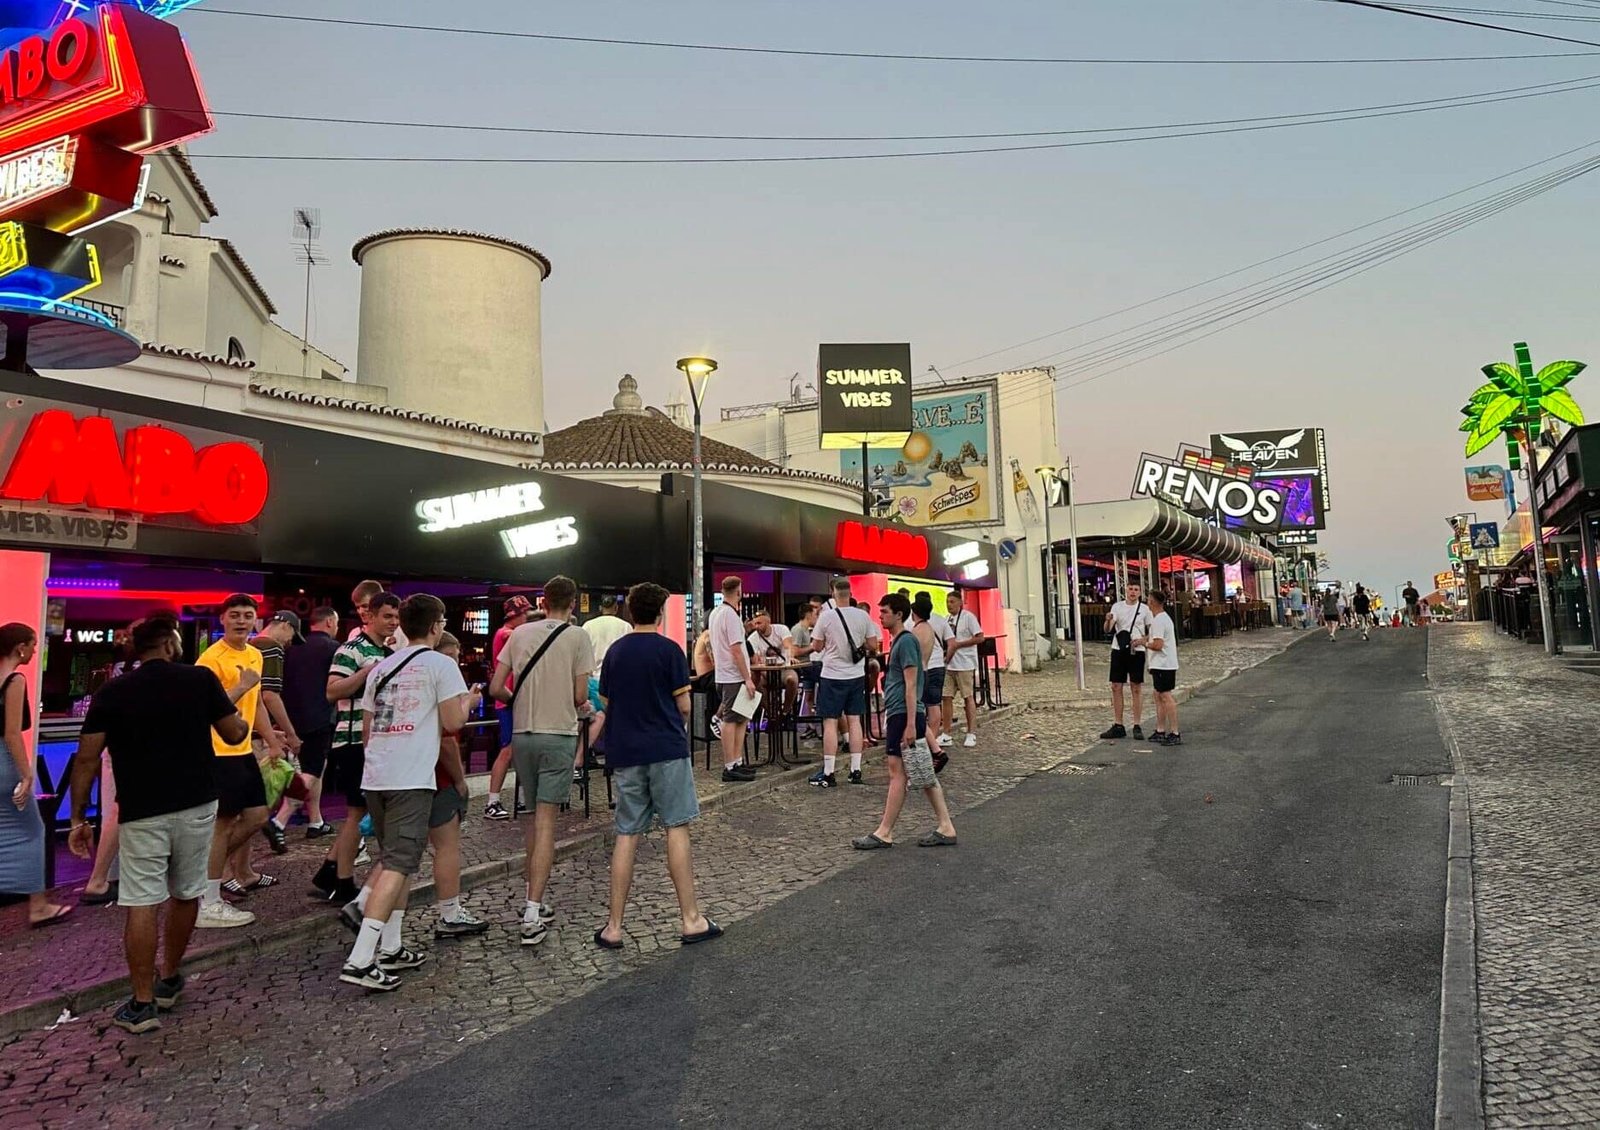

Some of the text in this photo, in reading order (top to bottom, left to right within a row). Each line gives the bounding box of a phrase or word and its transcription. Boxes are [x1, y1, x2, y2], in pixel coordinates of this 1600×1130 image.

[825, 368, 906, 386] SUMMER
[840, 391, 892, 408] VIBES
[1231, 449, 1299, 462] HEAVEN
[932, 487, 976, 514] Schweppes
[1138, 460, 1280, 524] RENOS
[61, 515, 128, 540] VIBES
[77, 630, 104, 643] WC
